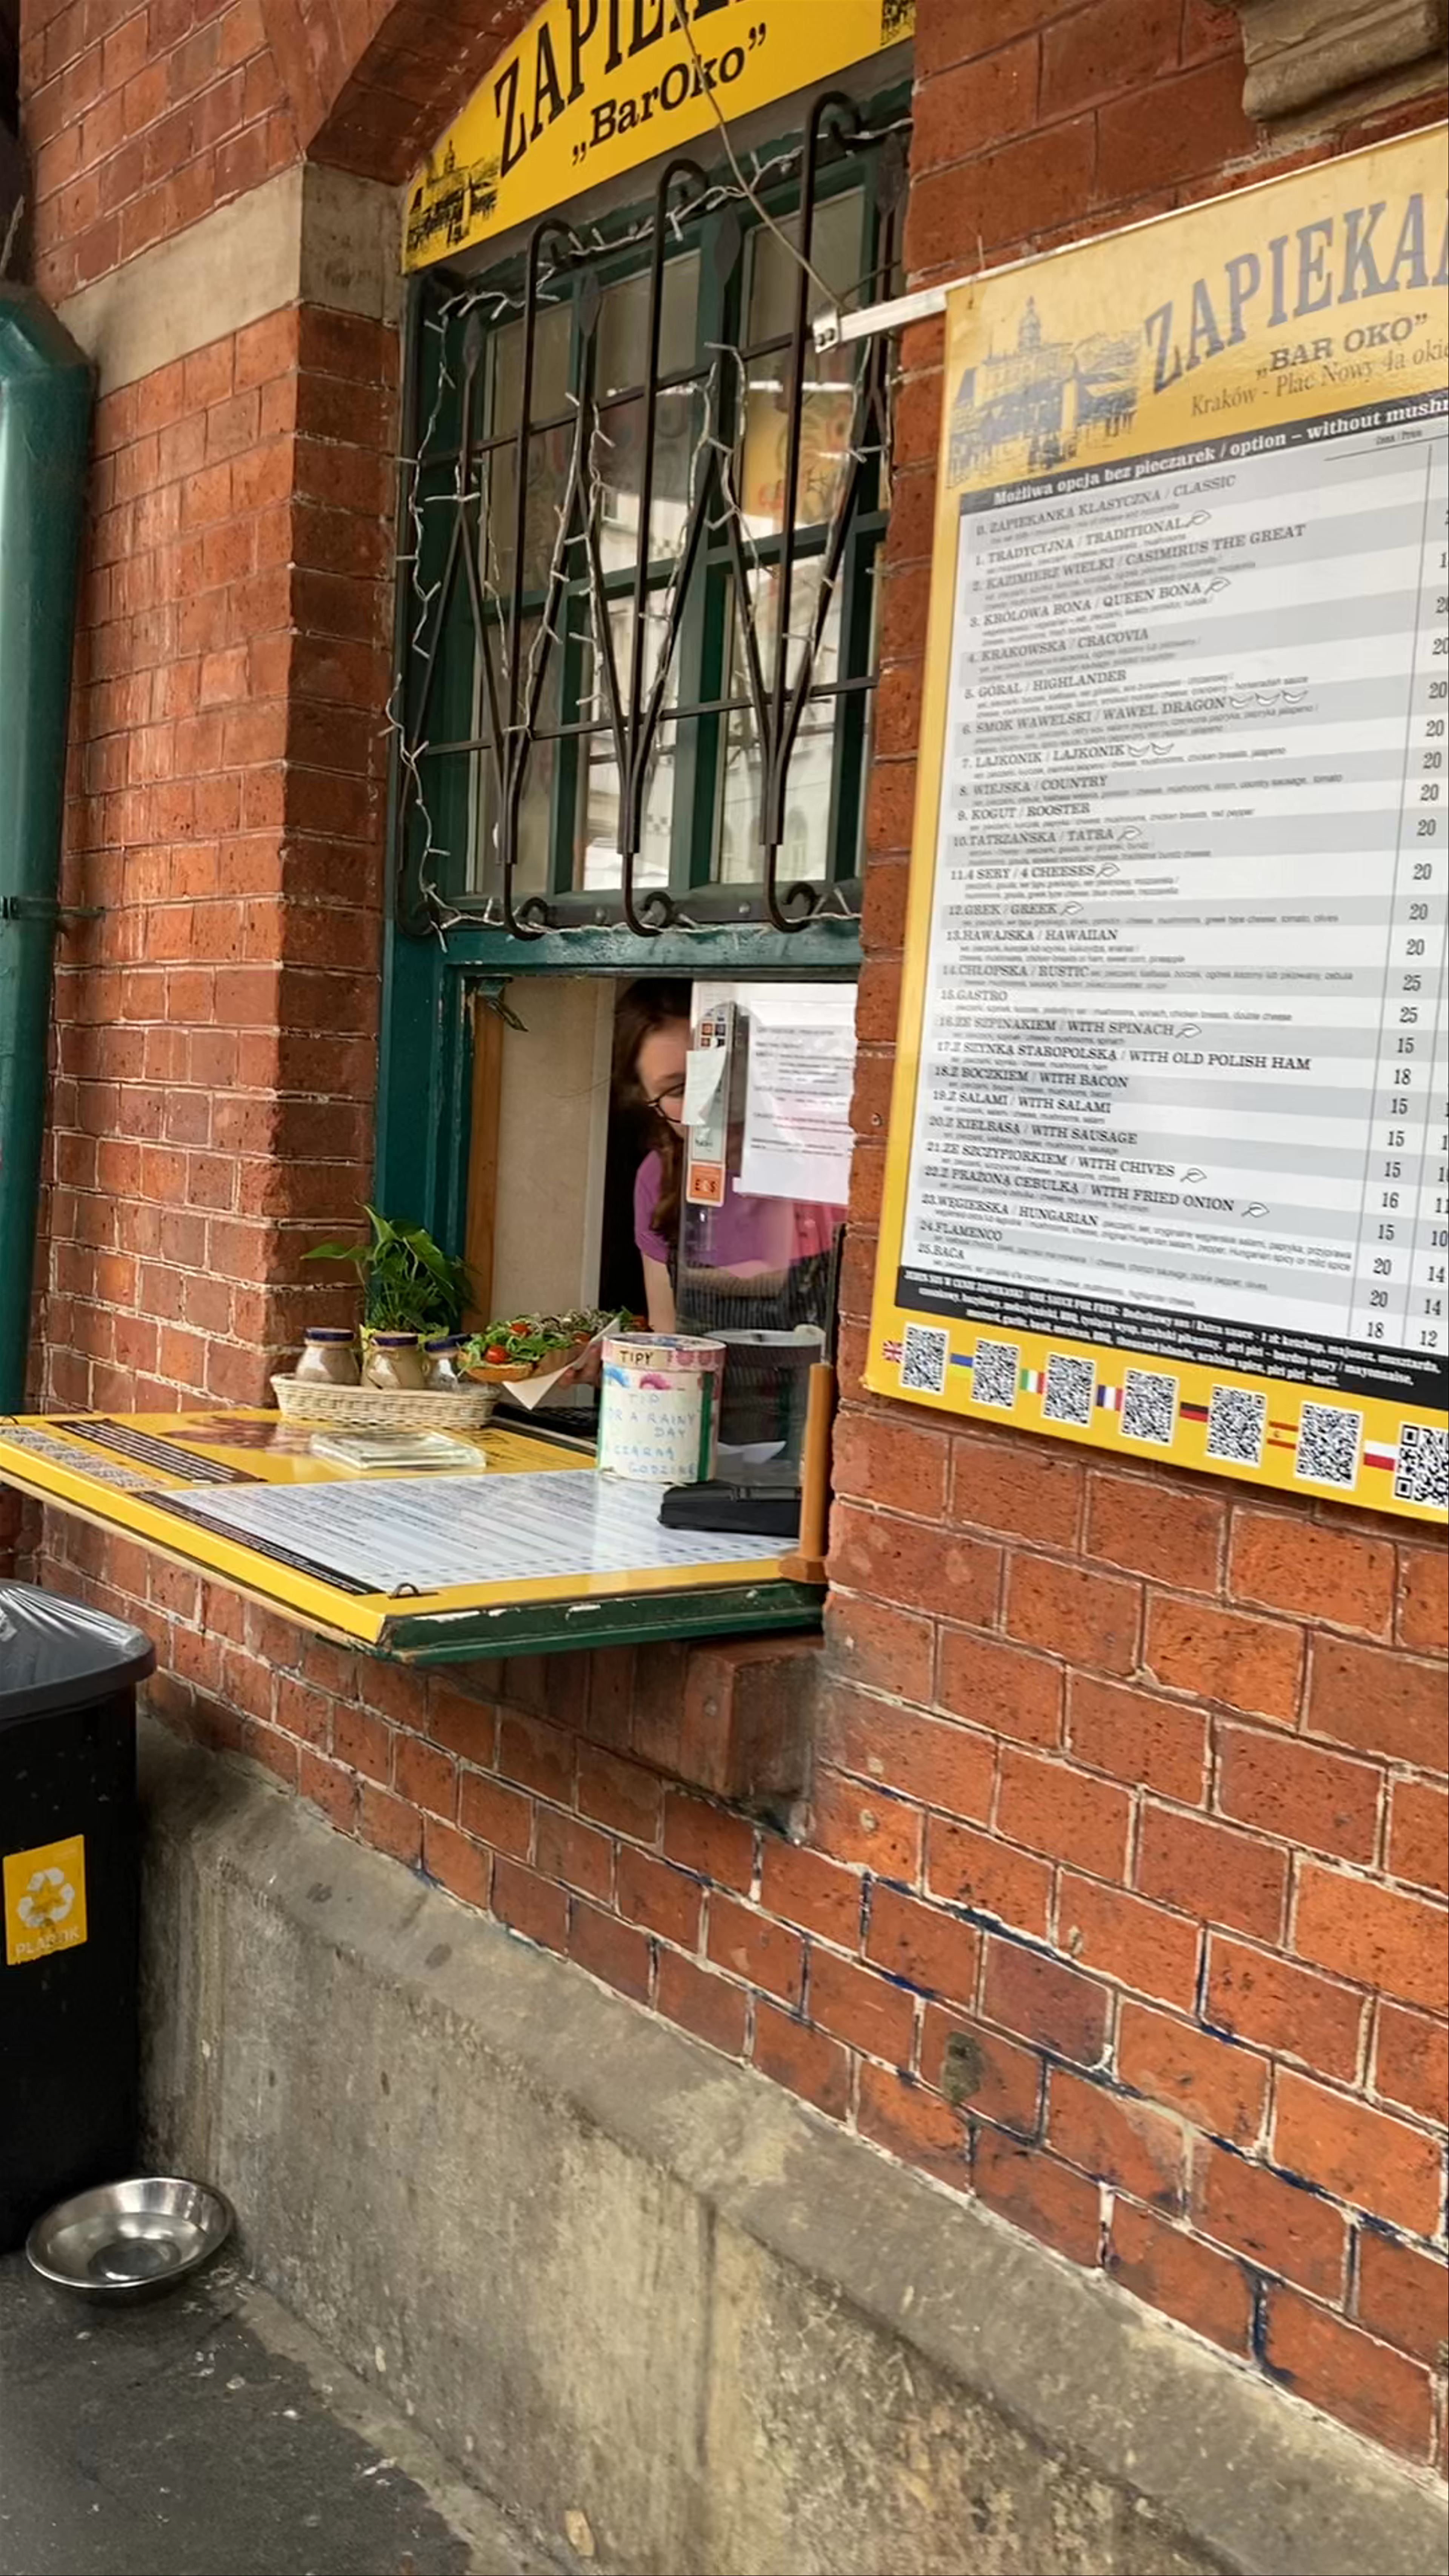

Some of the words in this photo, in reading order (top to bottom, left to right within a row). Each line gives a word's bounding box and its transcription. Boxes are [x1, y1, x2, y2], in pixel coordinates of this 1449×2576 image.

[1191, 388, 1258, 416] Kraków
[1277, 368, 1314, 397] Plac
[1321, 361, 1372, 387] Nowy
[1383, 349, 1406, 372] 4a
[1057, 470, 1100, 494] opcja
[1104, 463, 1132, 484] bez
[1134, 445, 1215, 478] pieczarek
[1229, 430, 1287, 458] option
[1306, 410, 1381, 442] without
[1173, 474, 1236, 498] CLASSIC
[1086, 517, 1183, 546] TRADITIONAL
[1061, 556, 1115, 577] WIELKI
[1125, 540, 1209, 566] CASIMIRUS
[1211, 533, 1246, 552] THE
[1249, 523, 1306, 545] GREAT
[1052, 598, 1092, 616] BONA
[1102, 588, 1154, 608] QUEEN
[1159, 581, 1203, 600] BONA
[1077, 627, 1149, 649] CRACOVIA
[1032, 669, 1127, 692] HIGHLANDER
[1427, 680, 1449, 699] 20
[976, 719, 1014, 734] SMOK
[1016, 711, 1091, 730] WAWELSKI
[1102, 704, 1159, 721] WAWEL
[1161, 697, 1226, 715] DRAGON
[1425, 719, 1446, 737] 20
[976, 751, 1042, 768] LAJKONIK
[1052, 744, 1125, 762] LAJKONIK
[1422, 751, 1443, 769] 20
[974, 780, 1031, 796] WIEJSKA
[1040, 775, 1108, 792] COUNTRY
[1419, 783, 1440, 801] 20
[971, 807, 1017, 821] KOGUT
[1026, 802, 1091, 817] ROOSTER
[1068, 827, 1115, 842] TATRA
[1416, 818, 1437, 837] 20
[975, 867, 1011, 880] SERY
[1020, 867, 1029, 878] 4
[1031, 864, 1097, 878] CHEESES
[1412, 863, 1433, 880] 20
[1010, 903, 1058, 915] GREEK
[1408, 903, 1429, 920] 20
[1044, 929, 1118, 941] HAWAIIAN
[1405, 938, 1426, 956] 20
[1038, 965, 1090, 978] RUSTIC
[1402, 974, 1423, 992] 25
[1399, 1007, 1419, 1024] 25
[1066, 1021, 1104, 1033] WITH
[1108, 1022, 1175, 1036] SPINACH
[1397, 1037, 1415, 1054] 15
[1128, 1050, 1169, 1064] WITH
[1172, 1052, 1204, 1066] OLD
[1207, 1053, 1267, 1069] POLISH
[1271, 1057, 1312, 1072] HAM
[960, 1067, 1029, 1082] BOCZKIEM
[1038, 1071, 1076, 1085] WITH
[1080, 1074, 1129, 1089] BACON
[1393, 1067, 1412, 1086] 18
[958, 1092, 1008, 1106] SALAMI
[1018, 1096, 1054, 1110] WITH
[1057, 1098, 1112, 1114] SALAMI
[1390, 1097, 1409, 1115] 15
[1031, 1124, 1068, 1139] WITH
[1071, 1127, 1139, 1145] SAUSAGE
[1387, 1129, 1406, 1147] 15
[1078, 1155, 1117, 1171] WITH
[1119, 1160, 1176, 1177] CHIVES
[1383, 1161, 1402, 1178] 15
[1090, 1184, 1129, 1200] WITH
[1133, 1189, 1180, 1206] FRIED
[1182, 1194, 1235, 1212] ONION
[1381, 1191, 1400, 1209] 16
[1019, 1205, 1099, 1227] HUNGARIAN
[1377, 1223, 1396, 1241] 15
[1430, 1229, 1449, 1248] 10
[1372, 1257, 1393, 1276] 20
[1426, 1265, 1446, 1284] 14
[1369, 1289, 1389, 1309] 20
[1423, 1298, 1443, 1316] 14
[1366, 1321, 1385, 1340] 18
[1419, 1329, 1438, 1348] 12
[620, 1350, 654, 1366] TIPY
[647, 1412, 696, 1425] RAINY
